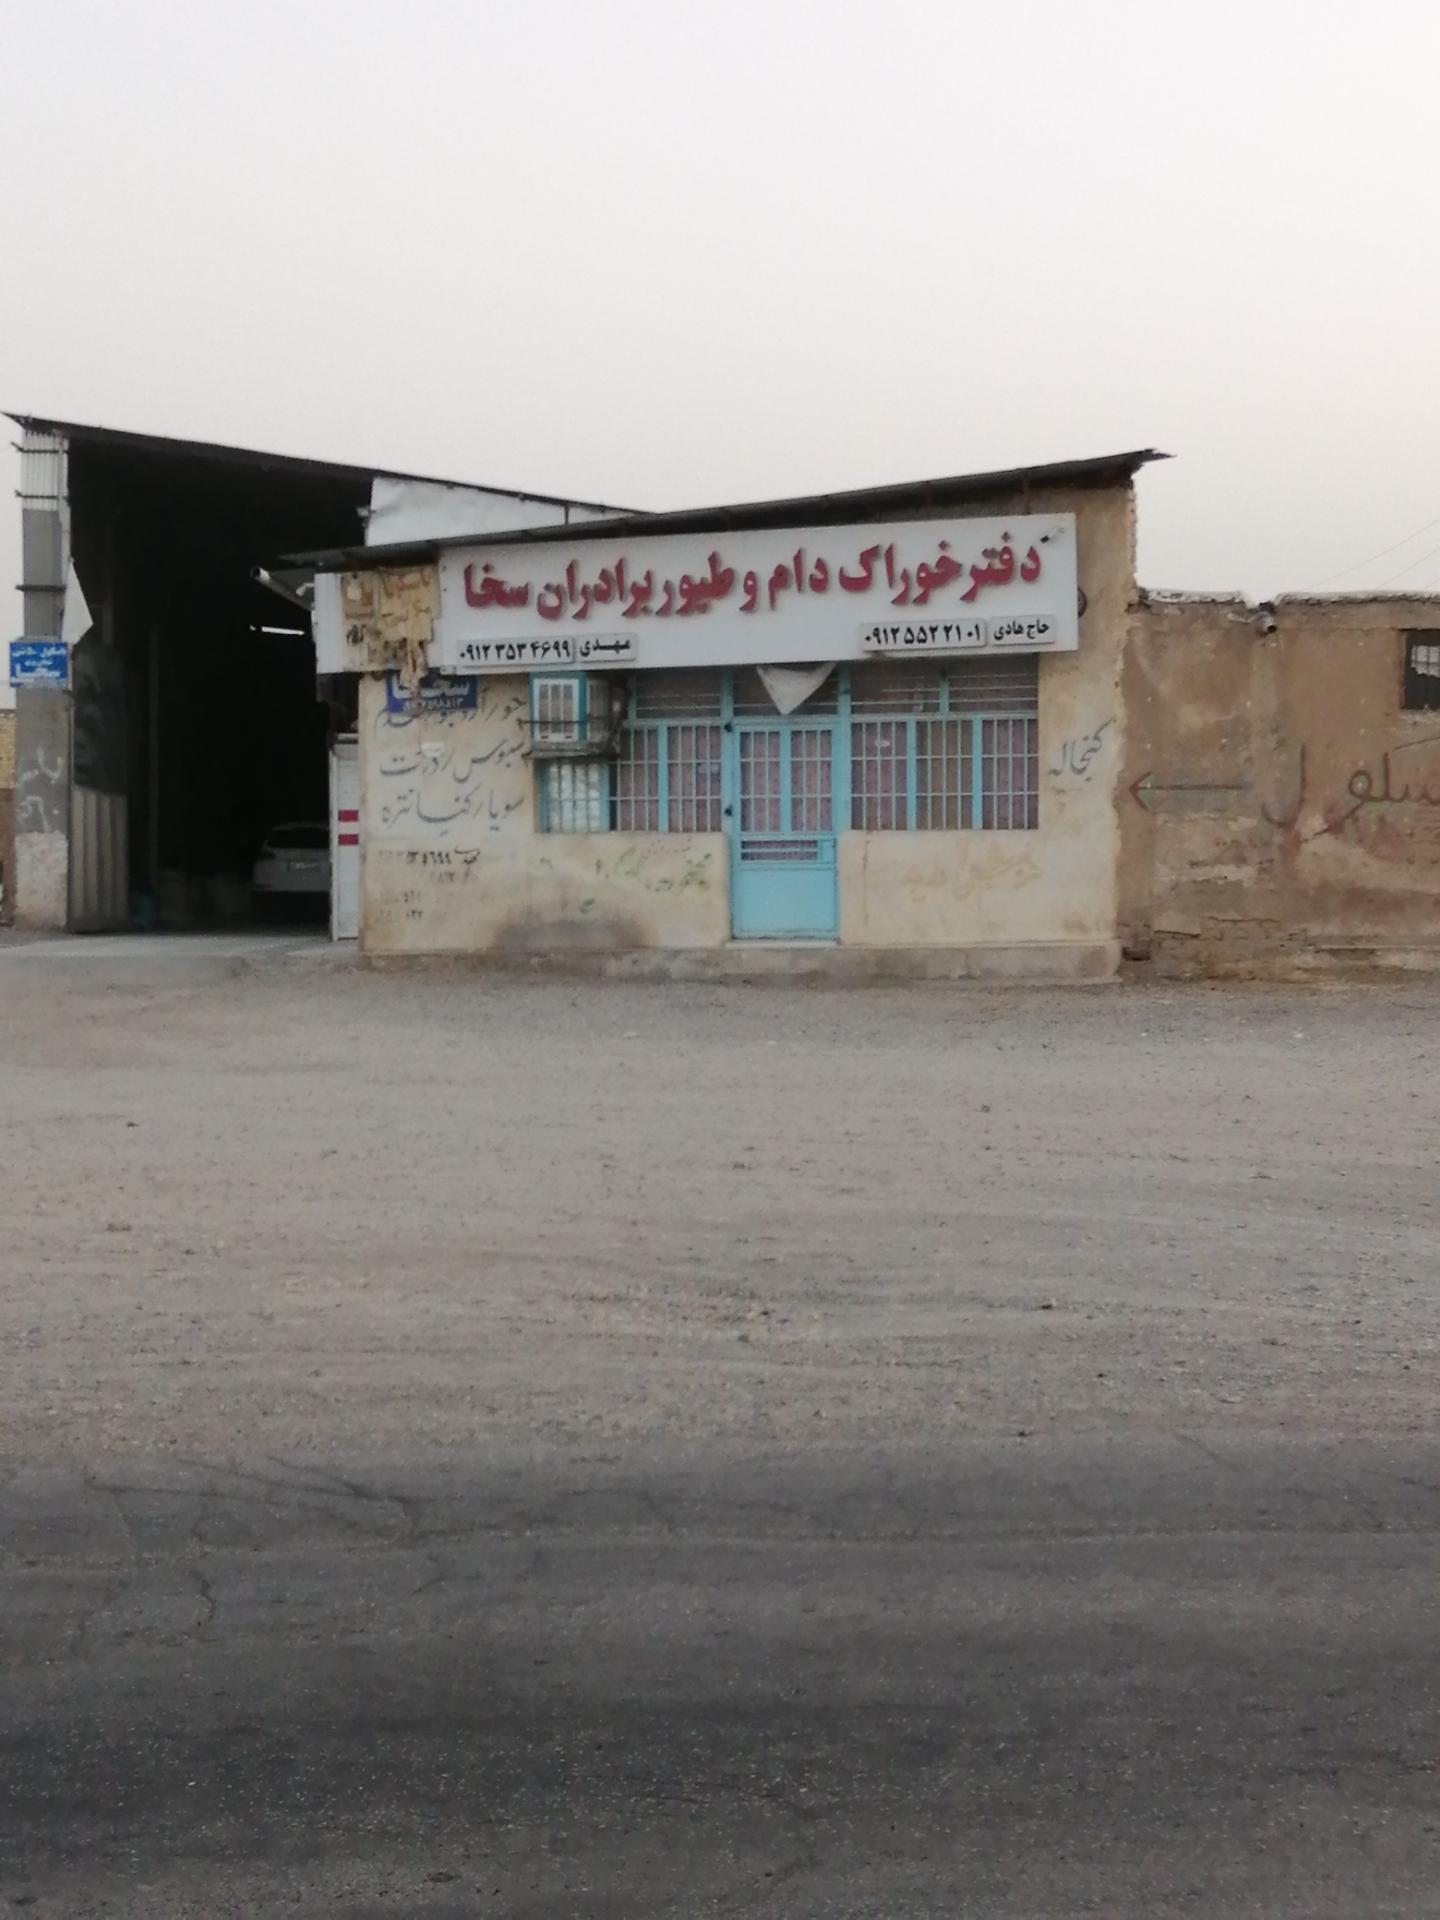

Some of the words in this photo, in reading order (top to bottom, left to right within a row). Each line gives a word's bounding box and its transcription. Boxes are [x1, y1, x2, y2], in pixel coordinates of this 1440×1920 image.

[463, 561, 530, 608] سخا
[536, 557, 653, 620] برادران
[655, 550, 736, 616] طیور
[739, 569, 759, 613] و
[768, 547, 829, 611] دام
[838, 540, 963, 605] خوراک
[960, 531, 1042, 602] دفتر
[579, 638, 631, 658] مهدی
[993, 619, 1025, 641] هادی
[1026, 618, 1050, 640] حاج
